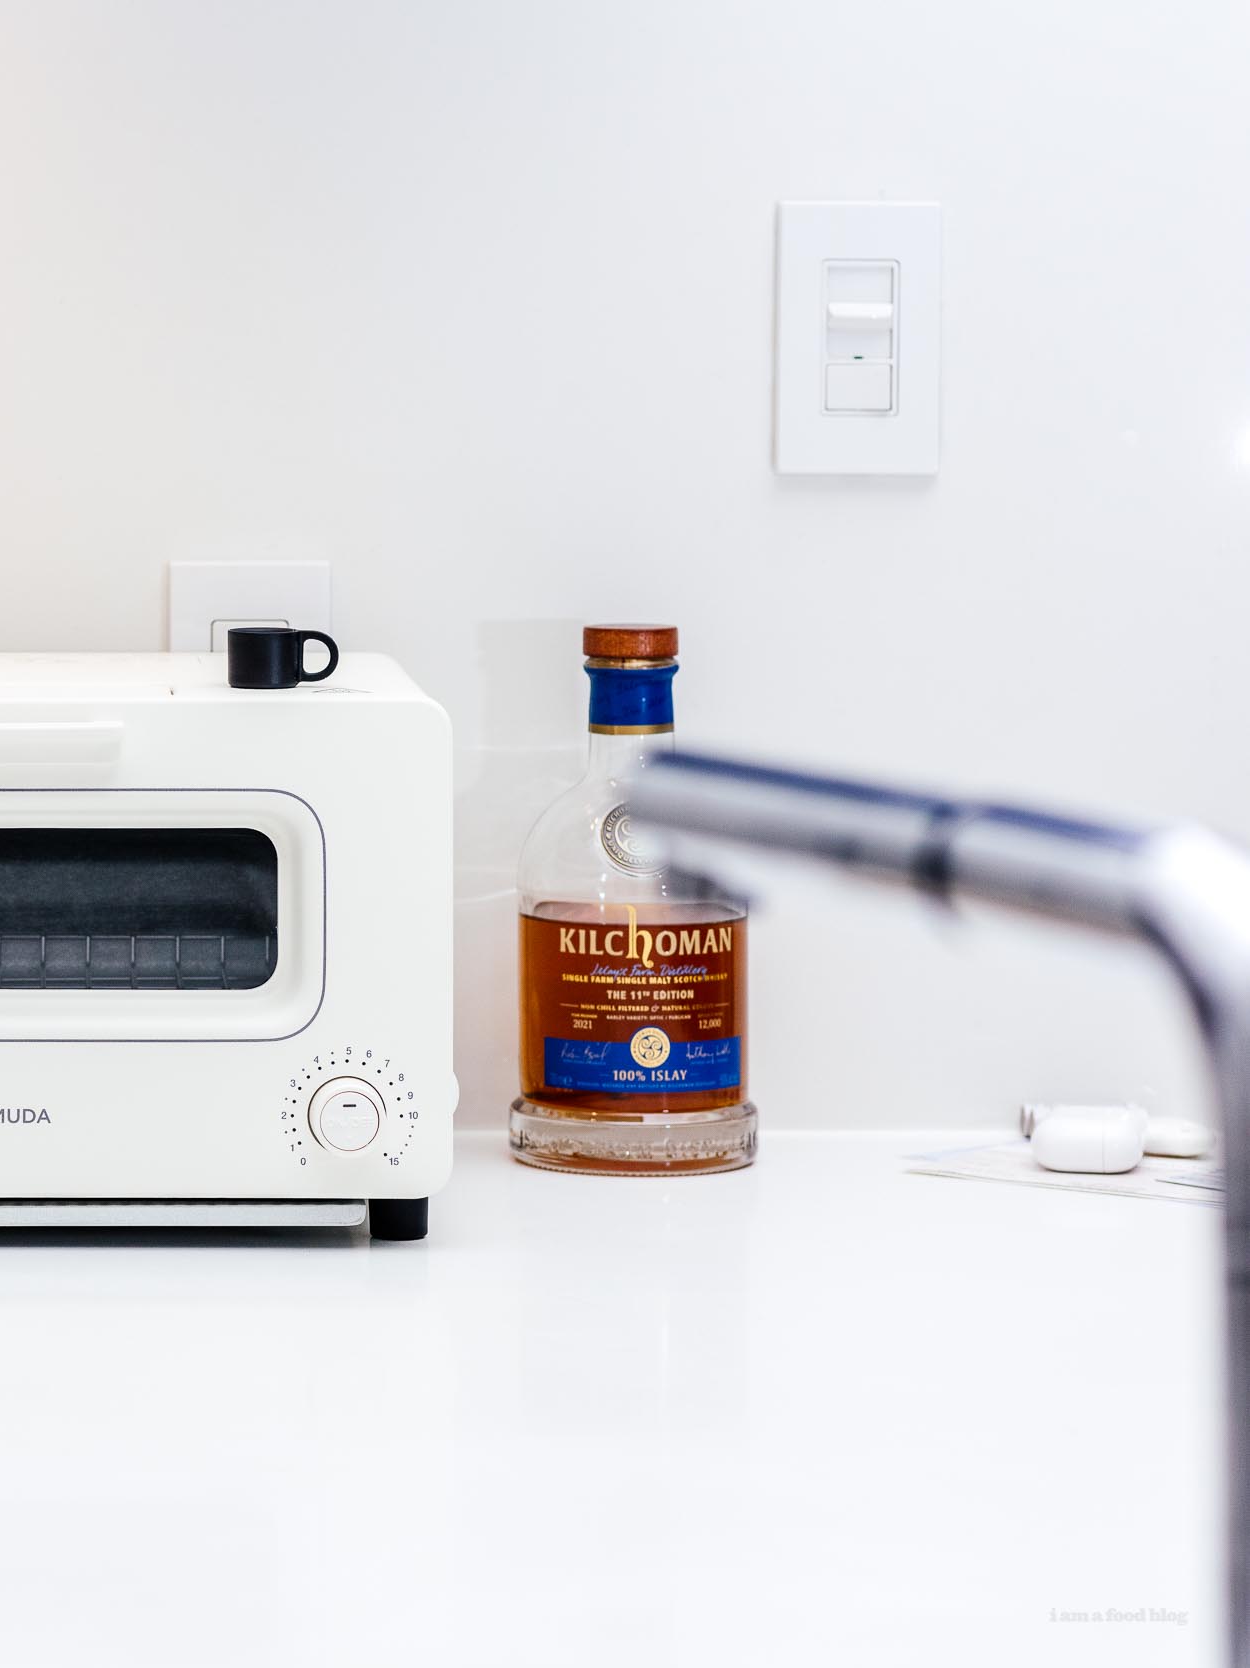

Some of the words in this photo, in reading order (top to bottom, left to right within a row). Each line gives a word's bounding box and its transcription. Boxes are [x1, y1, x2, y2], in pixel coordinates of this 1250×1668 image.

[630, 964, 656, 976] Farm
[660, 964, 708, 980] Distillery
[562, 973, 588, 983] SINGLE
[591, 975, 614, 984] FARM
[616, 976, 647, 985] SINGLE
[649, 976, 672, 985] MALT
[674, 975, 703, 984] SCOTCH
[606, 990, 627, 1000] THE
[653, 989, 694, 1000] EDITION
[651, 1003, 660, 1012] &
[661, 1004, 691, 1012] NATURAL
[573, 1019, 593, 1029] 2021
[698, 1018, 722, 1029] 12,000
[346, 1047, 352, 1055] 5
[366, 1050, 372, 1058] 6
[313, 1056, 319, 1064] 4
[613, 1070, 646, 1081] 100%
[651, 1069, 687, 1081] ISLAY
[290, 1144, 294, 1152] 1
